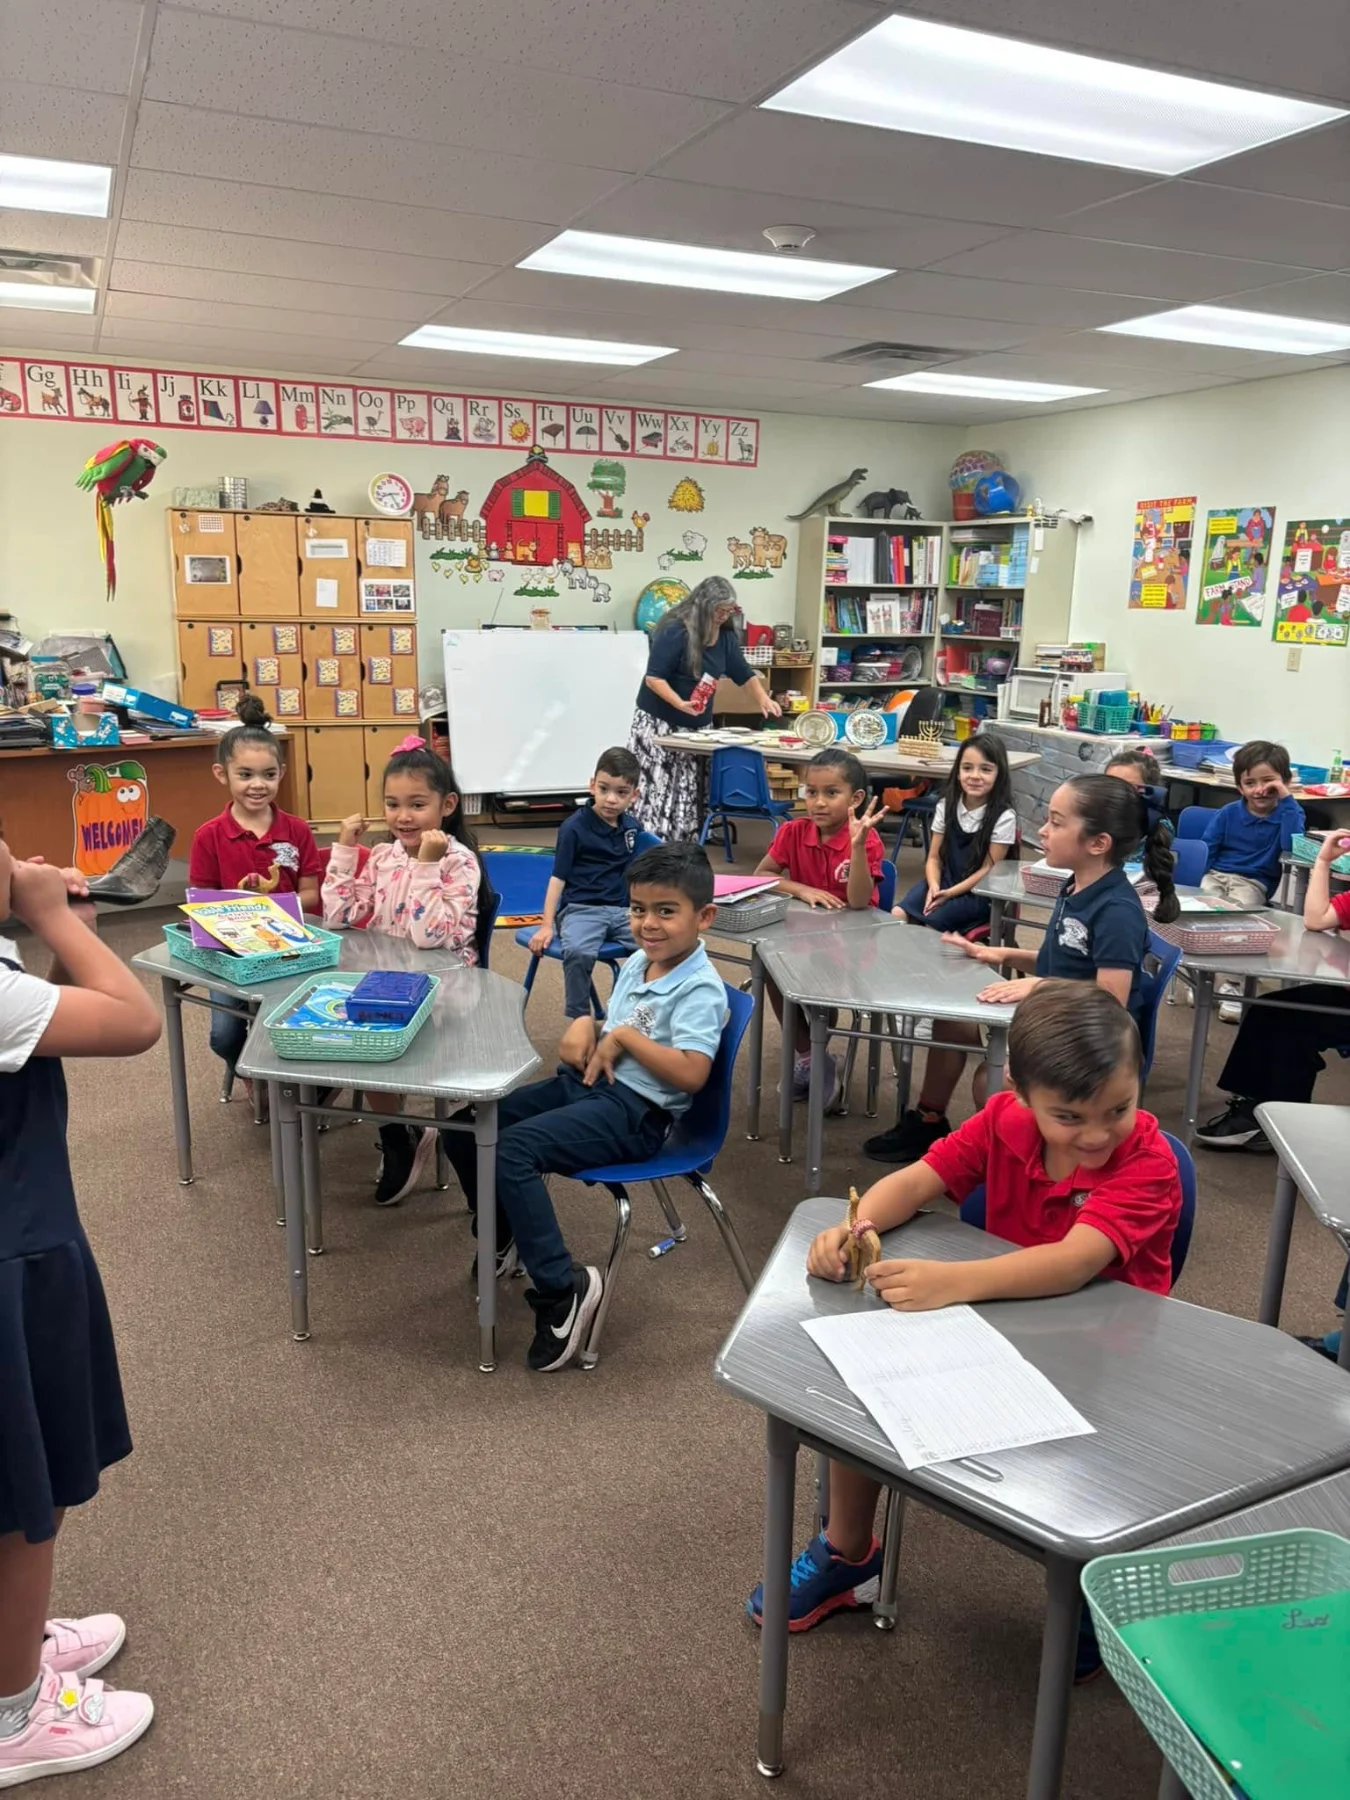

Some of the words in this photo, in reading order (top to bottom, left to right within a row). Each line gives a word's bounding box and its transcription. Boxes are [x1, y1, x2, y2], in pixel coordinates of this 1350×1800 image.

[27, 365, 56, 387] Gg
[72, 369, 103, 387] Hh
[116, 374, 132, 390] Ii
[160, 375, 176, 397] Jj
[200, 378, 228, 396] Kk
[242, 381, 261, 399] Ll
[281, 386, 314, 403] Mm
[320, 388, 346, 405] Nn
[359, 391, 384, 408] Oo
[397, 395, 416, 412] Pp
[433, 397, 454, 415] Qq
[469, 399, 490, 417] Rr
[504, 402, 522, 418] Ss
[537, 405, 554, 421] Tt
[572, 407, 594, 423] Uu
[605, 410, 625, 426] Vv
[637, 413, 664, 429] Ww
[670, 416, 690, 432] Xx
[701, 419, 721, 437] Yy
[731, 422, 750, 438] Zz
